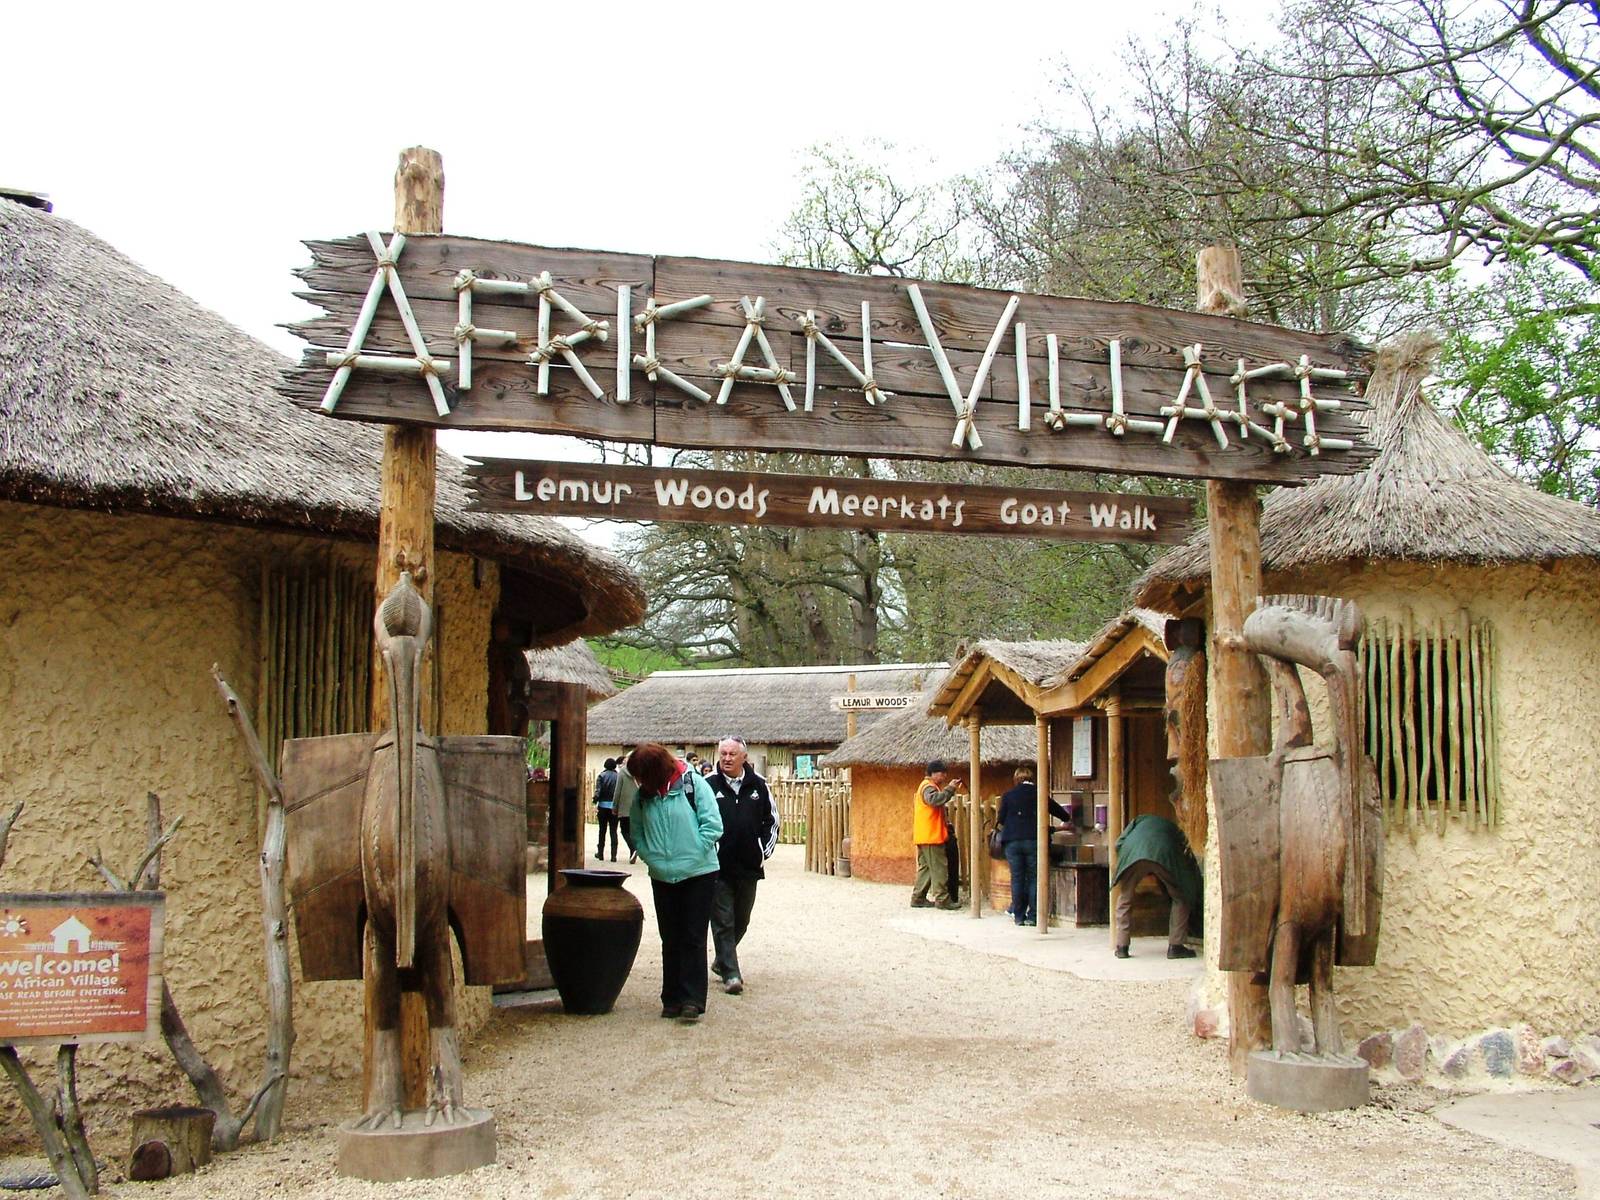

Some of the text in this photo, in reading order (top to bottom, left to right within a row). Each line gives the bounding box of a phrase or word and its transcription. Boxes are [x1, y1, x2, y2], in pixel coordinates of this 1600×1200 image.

[321, 230, 1353, 455] AFRICAN VILLAGE
[514, 470, 1157, 532] Lemur Woods Meerkats Goat Walk
[842, 698, 872, 707] LEMUR
[875, 697, 908, 706] WOODS
[14, 976, 65, 989] African
[71, 975, 118, 987] Village
[44, 989, 76, 998] BEFORE
